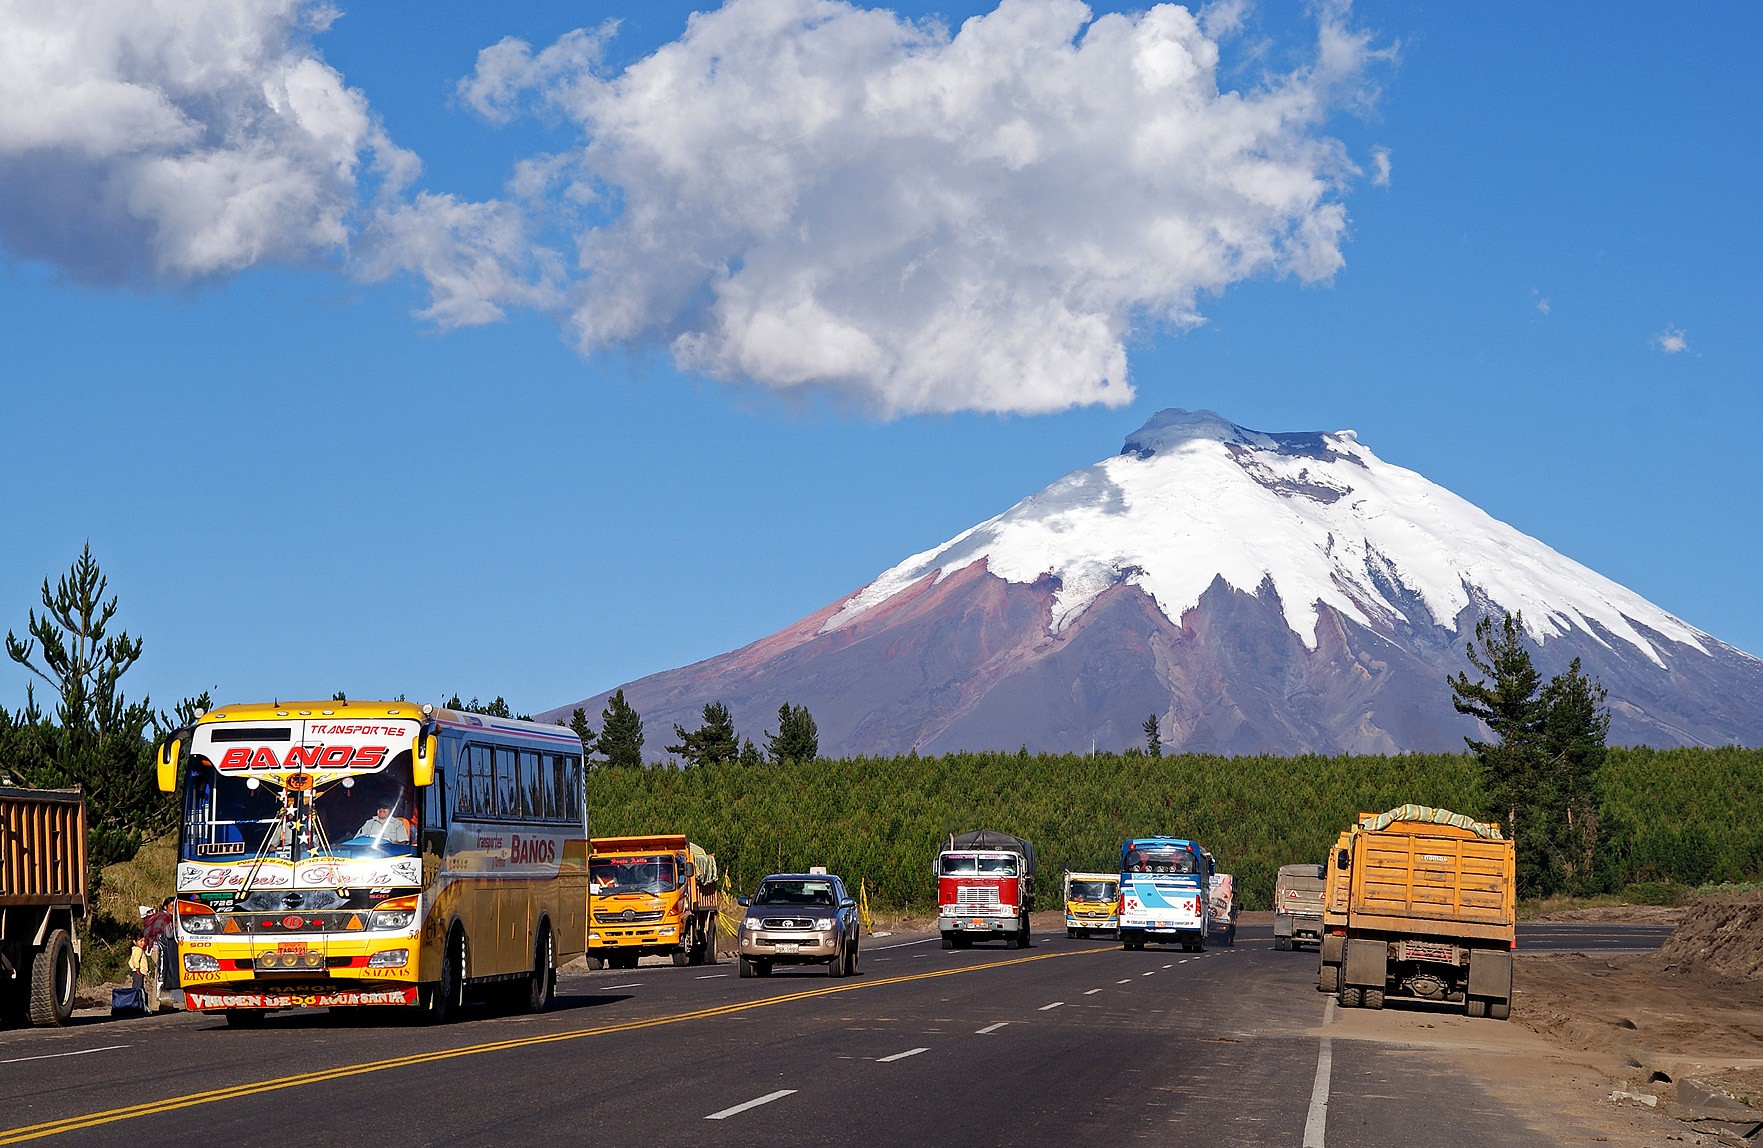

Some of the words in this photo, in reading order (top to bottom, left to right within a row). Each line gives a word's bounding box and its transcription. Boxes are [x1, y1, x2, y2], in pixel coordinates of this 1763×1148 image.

[311, 725, 406, 737] TRANSPORTES
[510, 834, 555, 864] BAÑOS
[407, 929, 420, 941] 58
[362, 968, 410, 978] SALINAS
[190, 993, 261, 1009] VIRGEN
[264, 994, 292, 1007] DE
[319, 992, 360, 1006] AGUA
